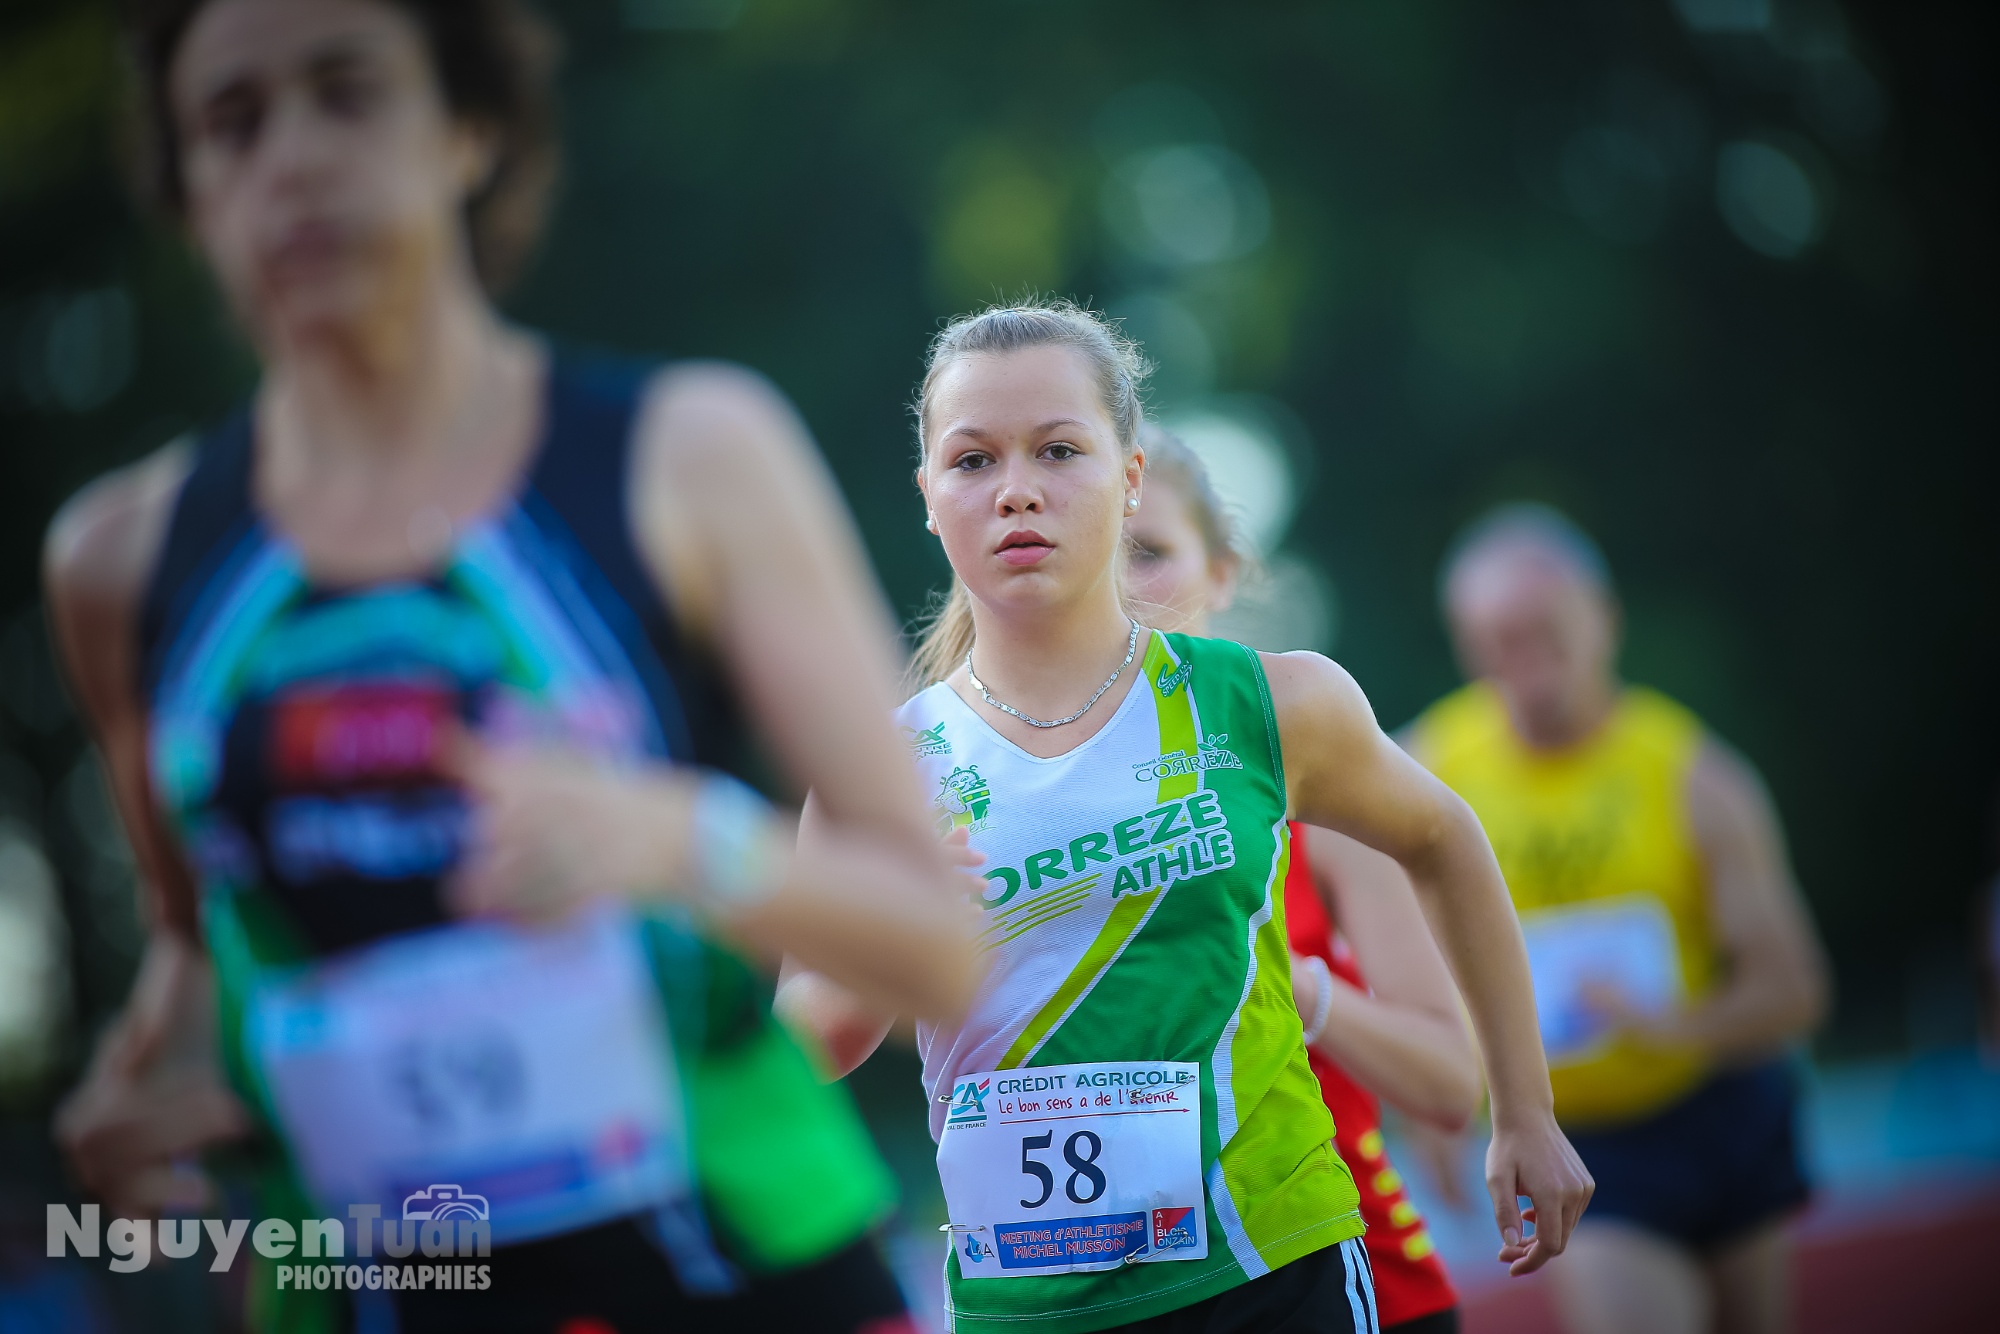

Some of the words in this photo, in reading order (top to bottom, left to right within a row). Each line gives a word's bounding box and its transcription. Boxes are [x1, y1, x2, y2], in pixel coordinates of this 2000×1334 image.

[1132, 758, 1157, 769] Conseil
[974, 793, 1223, 911] ORREZE
[1111, 833, 1232, 899] ATHLE
[997, 1075, 1066, 1094] CRÉDIT
[1075, 1070, 1189, 1088] AGRICOLE
[1018, 1097, 1040, 1112] bon
[1046, 1097, 1073, 1110] sens
[1080, 1096, 1088, 1108] a
[1094, 1091, 1111, 1106] de
[965, 1121, 987, 1129] FRANCE
[1019, 1129, 1107, 1209] 58
[1000, 1230, 1051, 1245] MEETING
[1013, 1243, 1063, 1259] MICHEL
[1065, 1237, 1126, 1256] MUSSON
[1157, 1235, 1195, 1247] ONZAIN
